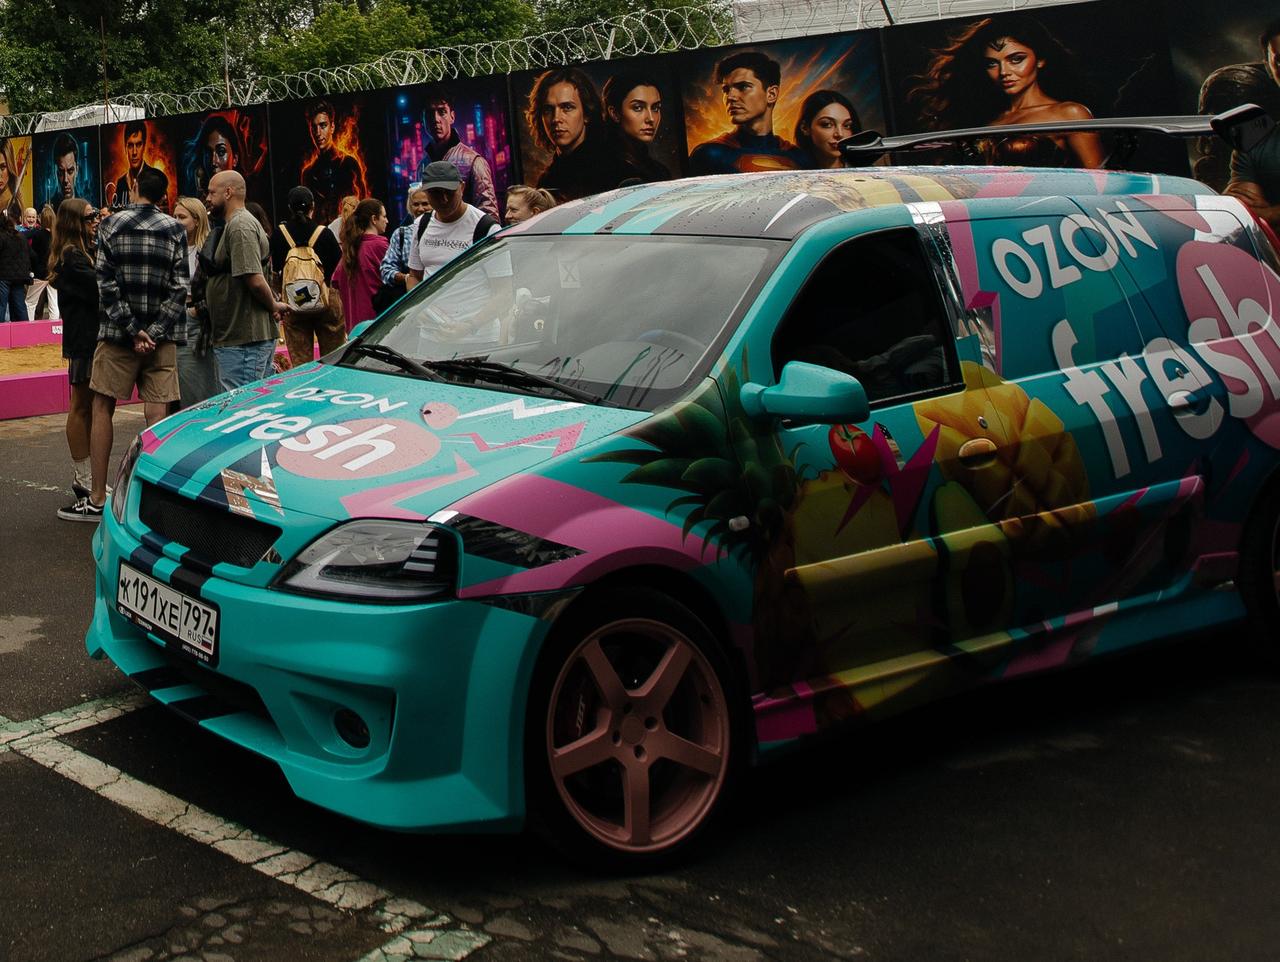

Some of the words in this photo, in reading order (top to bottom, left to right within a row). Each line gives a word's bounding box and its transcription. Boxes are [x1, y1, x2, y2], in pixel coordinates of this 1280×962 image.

[992, 201, 1158, 299] OZON
[1052, 264, 1280, 479] fresh
[285, 387, 408, 413] OZON
[203, 402, 397, 471] fresh
[183, 600, 211, 636] 797
[187, 629, 202, 644] RUS
